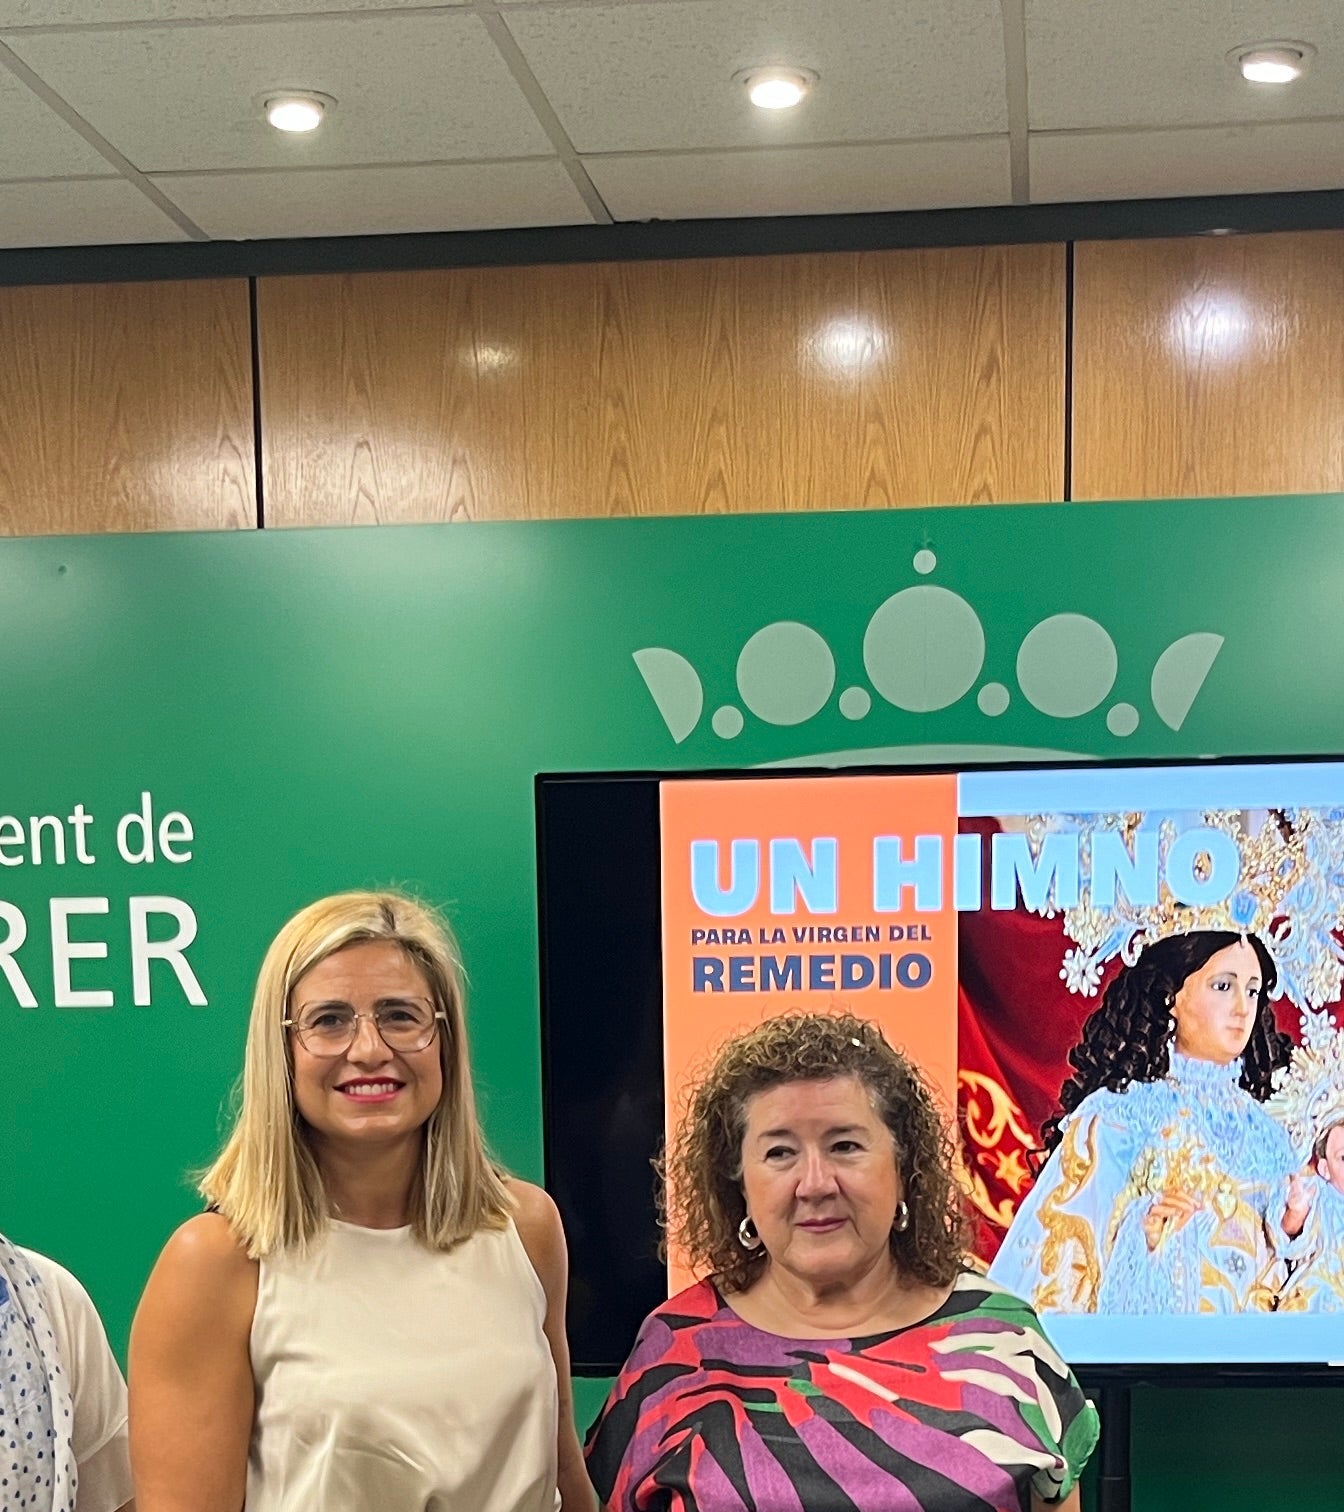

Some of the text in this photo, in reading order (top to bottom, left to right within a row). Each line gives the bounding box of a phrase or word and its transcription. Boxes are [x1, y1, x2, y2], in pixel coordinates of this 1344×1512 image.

[116, 791, 195, 864] de
[690, 827, 1241, 917] UN HIMNO
[692, 924, 932, 946] PARA LA VIRGEN DEL
[693, 953, 932, 993] REMEDIO
